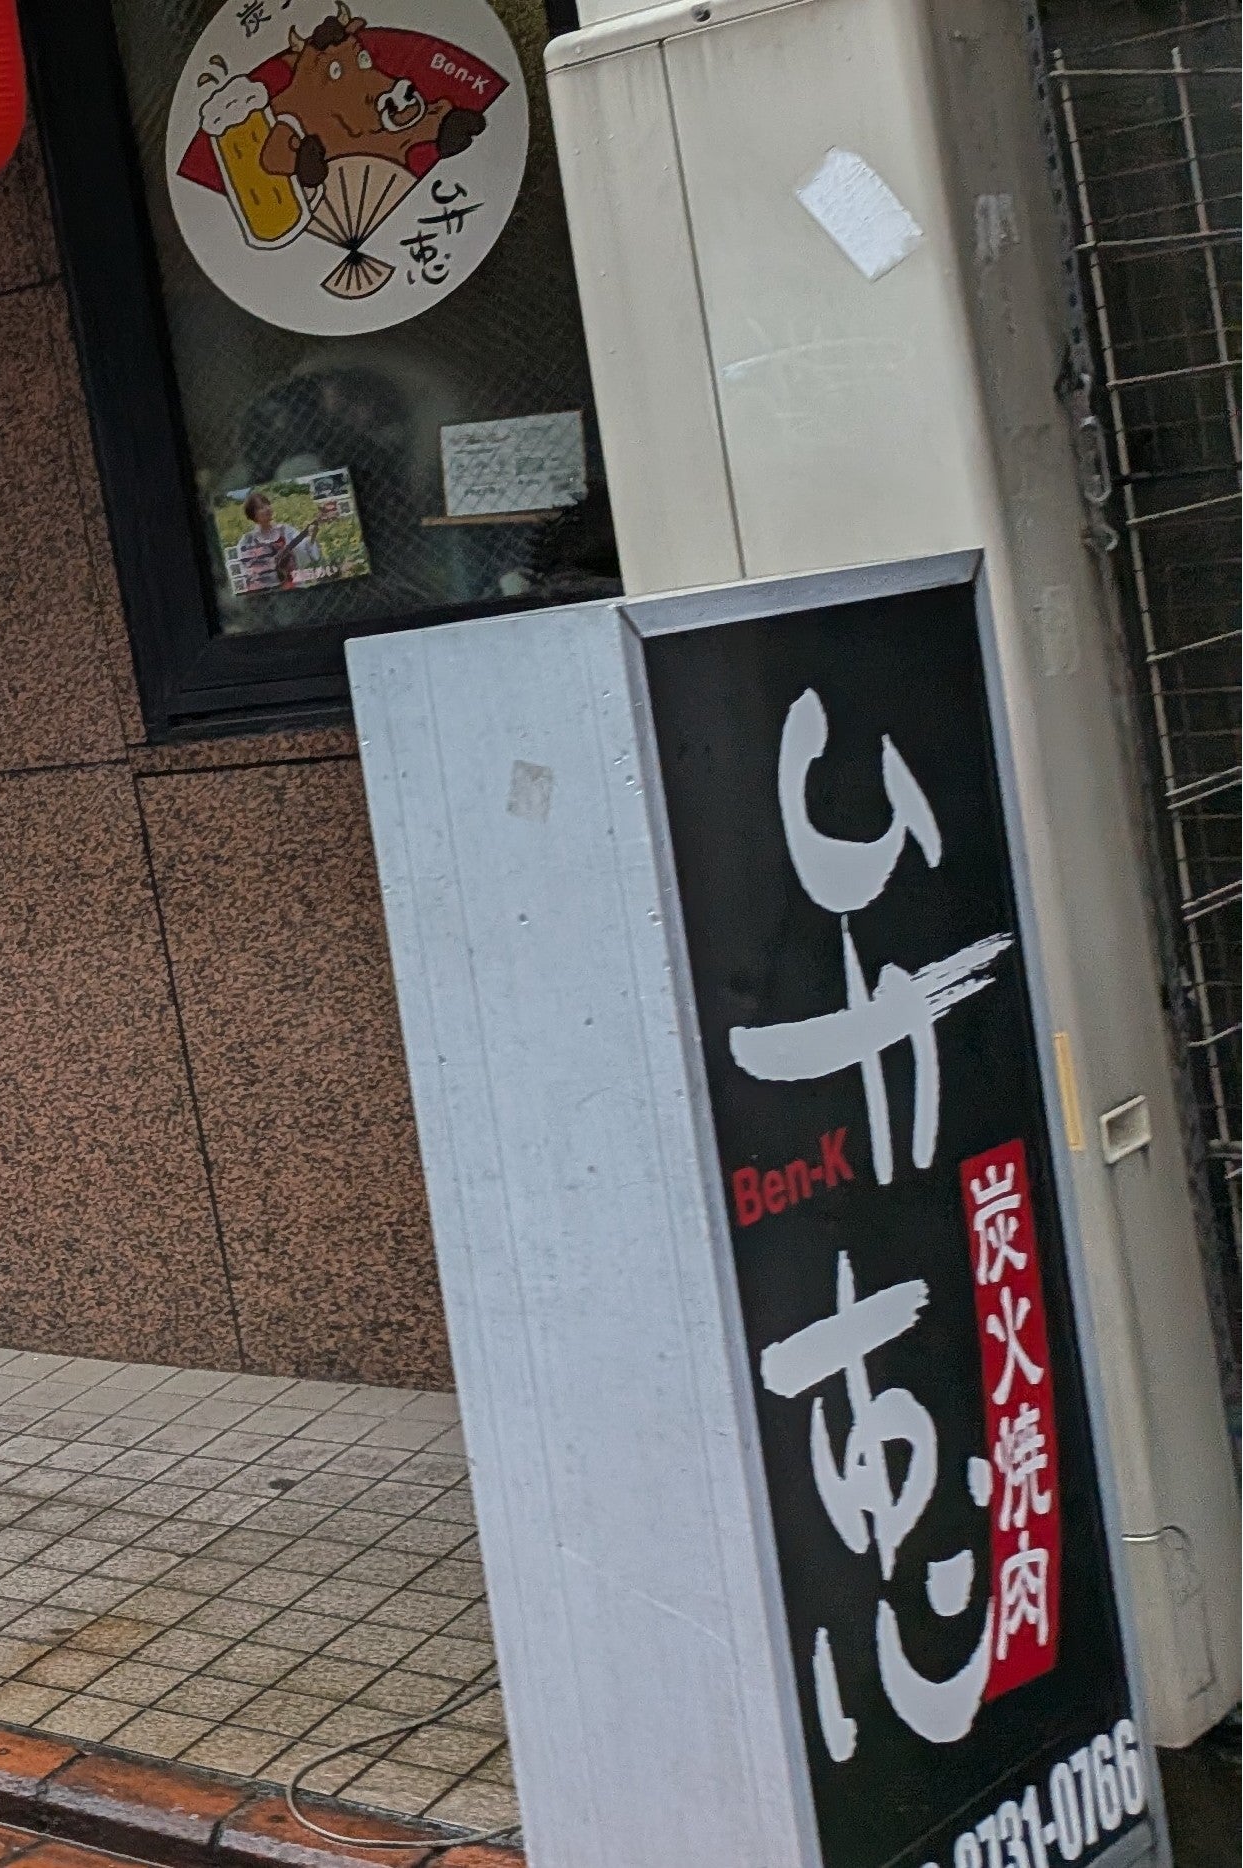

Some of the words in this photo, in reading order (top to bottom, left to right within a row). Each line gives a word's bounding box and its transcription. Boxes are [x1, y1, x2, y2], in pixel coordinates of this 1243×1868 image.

[430, 53, 490, 95] Ben-K
[732, 1127, 853, 1227] Ben-K
[970, 1162, 1051, 1660] 炭火焼肉
